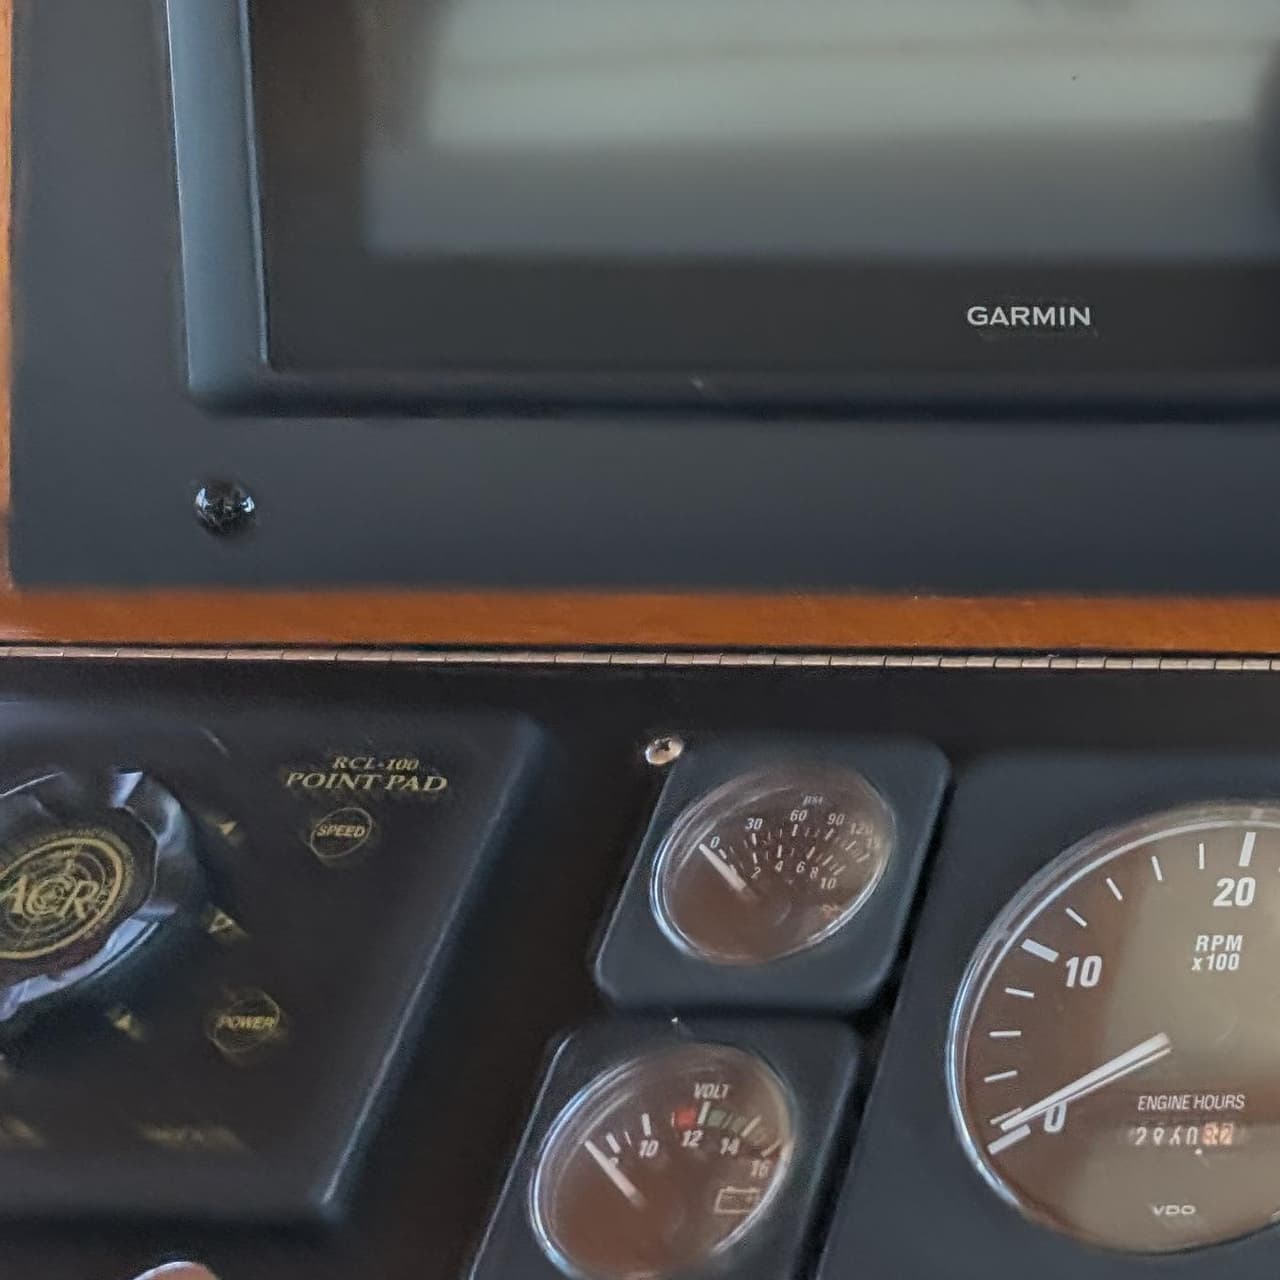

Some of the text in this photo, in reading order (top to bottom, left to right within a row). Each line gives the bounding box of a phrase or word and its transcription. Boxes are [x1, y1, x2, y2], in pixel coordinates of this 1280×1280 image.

[967, 306, 1090, 326] GARMIN
[332, 756, 419, 770] RCL-100
[285, 772, 448, 791] POINT PAD
[790, 810, 808, 821] 60
[827, 813, 845, 825] 90
[317, 824, 366, 837] SPEED
[745, 818, 763, 830] 30
[1212, 877, 1256, 907] 20
[1195, 935, 1243, 952] RPM
[1065, 956, 1103, 987] 10
[694, 1084, 731, 1099] VOLT
[1138, 1094, 1246, 1111] ENGINE HOURS
[682, 1130, 703, 1147] 12
[720, 1138, 740, 1155] 14
[639, 1141, 658, 1157] 10
[1152, 1205, 1197, 1216] VDO
